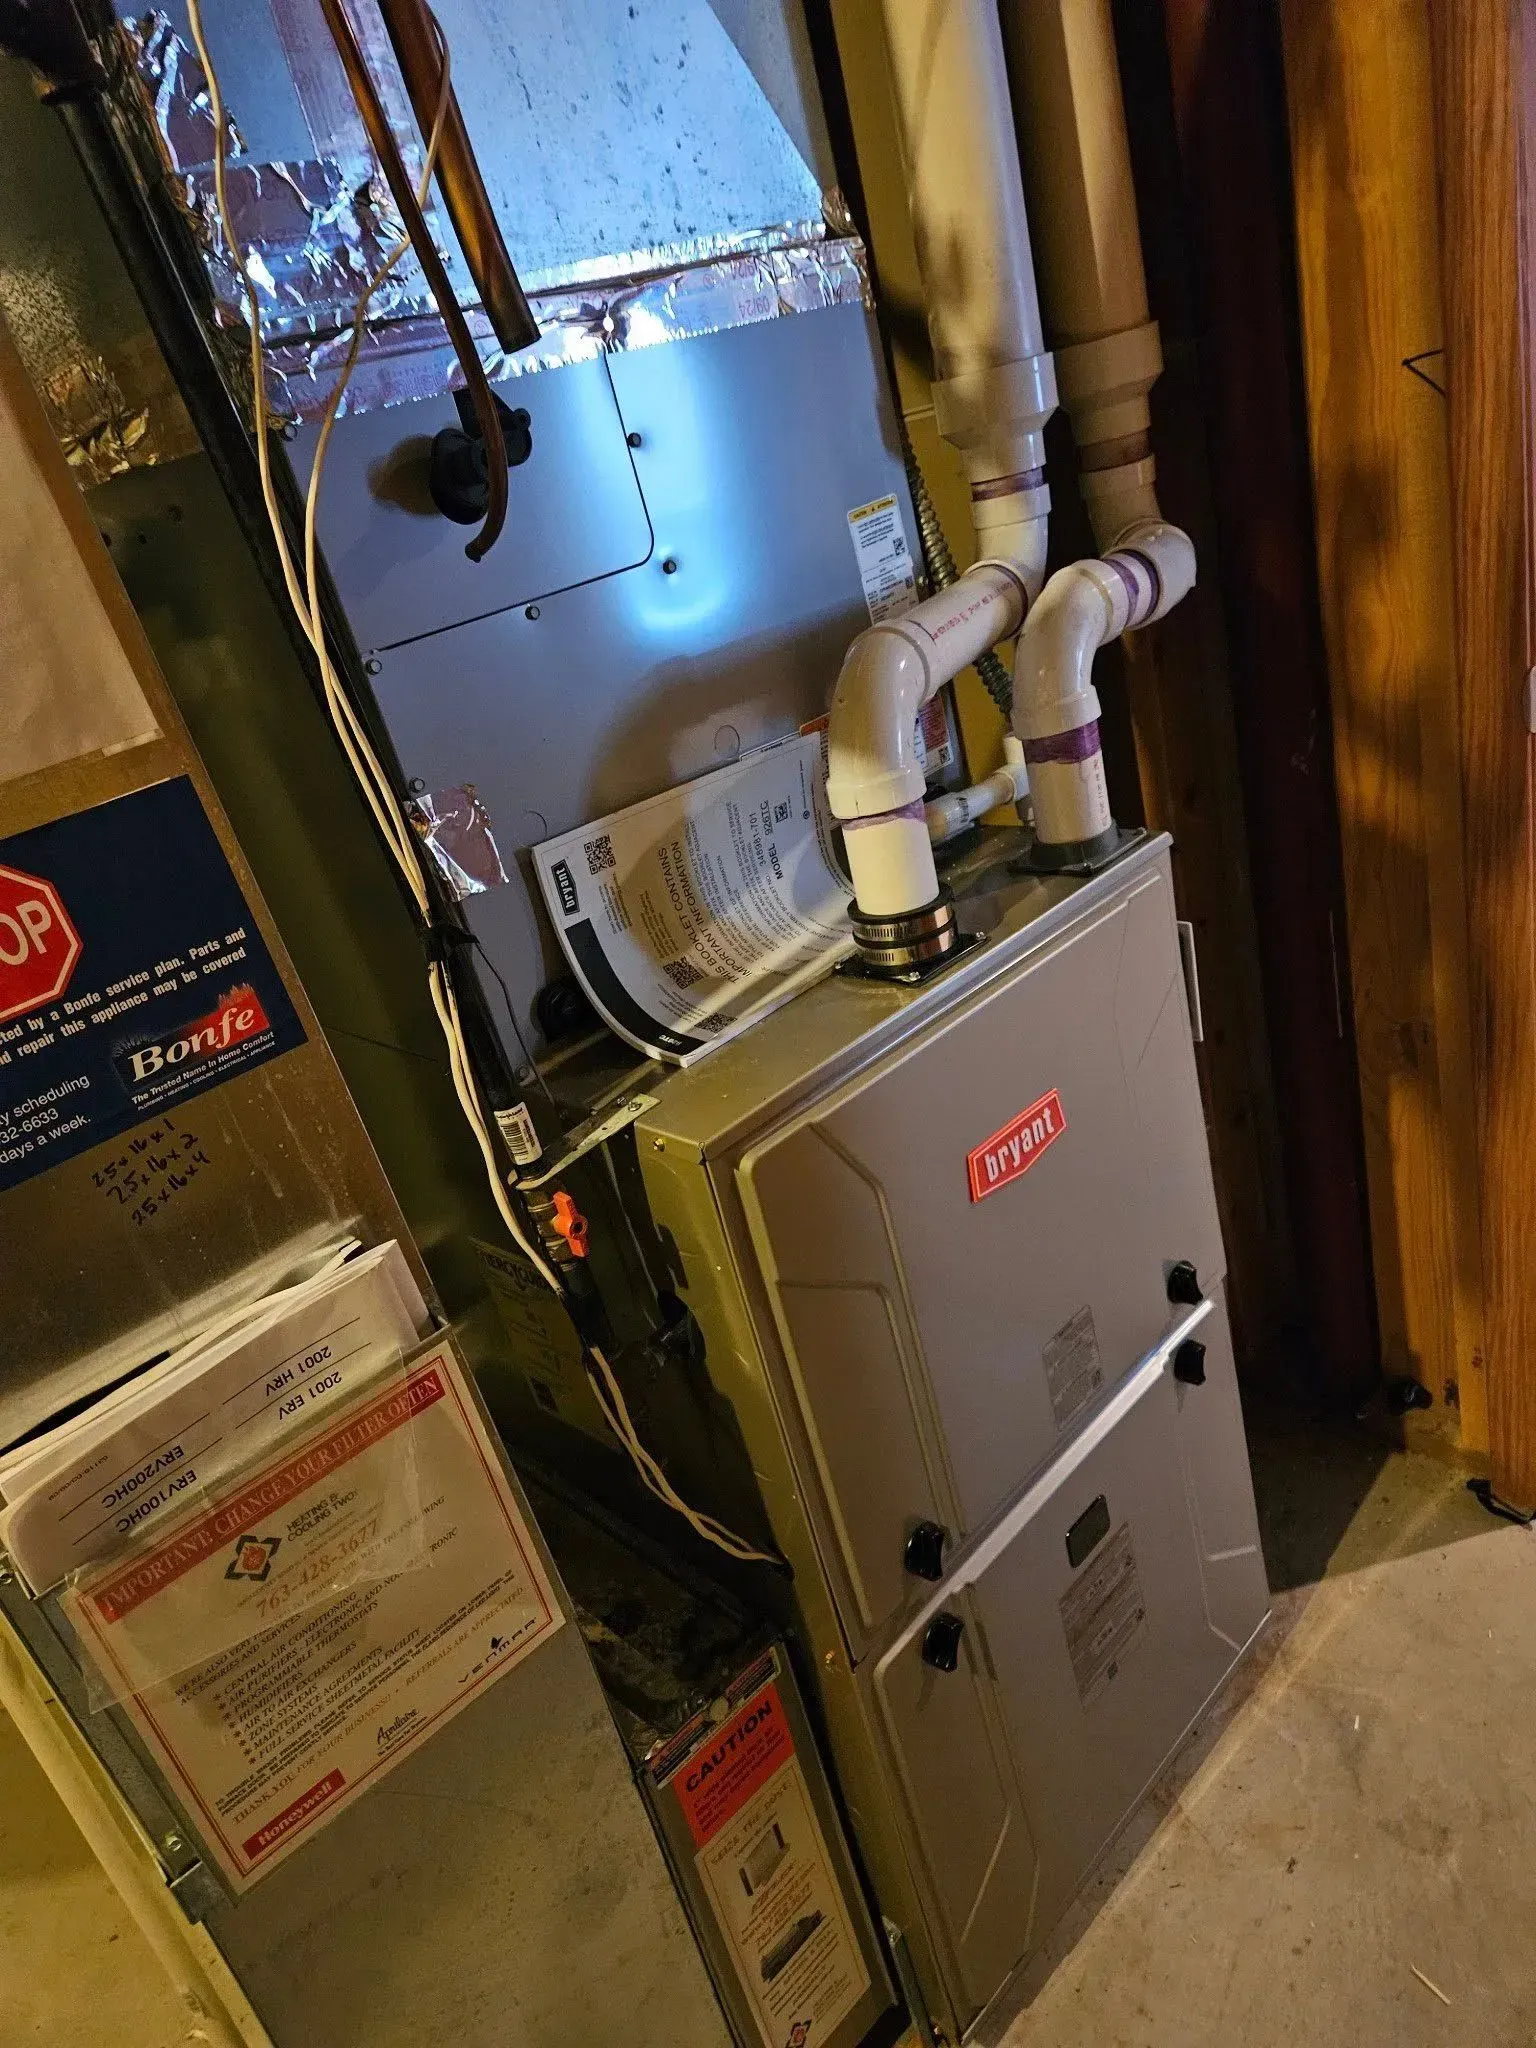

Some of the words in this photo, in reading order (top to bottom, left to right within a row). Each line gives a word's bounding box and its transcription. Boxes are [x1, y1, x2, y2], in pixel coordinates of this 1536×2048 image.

[759, 799, 772, 836] 926TC
[555, 866, 575, 908] bryant
[657, 846, 684, 911] CONTAINS
[670, 840, 704, 925] INFORMATION
[766, 842, 783, 879] MODEL
[678, 912, 717, 966] BOOKLET
[726, 915, 748, 943] APPLIANCE
[734, 906, 752, 931] BOOKLET
[700, 925, 752, 977] IMPORTANT
[714, 964, 739, 983] THIS
[0, 1024, 23, 1046] ted
[26, 1014, 46, 1033] by
[49, 1009, 60, 1021] a
[63, 989, 102, 1015] Bonfe
[104, 968, 151, 998] service
[152, 952, 185, 977] plan.
[188, 937, 220, 960] Parts
[223, 926, 246, 945] and
[15, 1031, 57, 1059] repair
[59, 1017, 86, 1037] this
[89, 989, 150, 1027] appliance
[152, 977, 179, 998] may
[181, 967, 198, 983] be
[201, 946, 247, 975] covered
[128, 1005, 256, 1083] Bonfe
[131, 1091, 149, 1105] The
[149, 1075, 182, 1096] Trusted
[181, 1062, 207, 1080] Name
[206, 1058, 217, 1068] In
[216, 1046, 241, 1063] Home
[241, 1030, 274, 1051] Comfort
[218, 1055, 246, 1071] ELECTRICAL
[250, 1040, 275, 1055] APPLIANCE
[11, 1072, 91, 1119] scheduling
[0, 1140, 34, 1164] days
[37, 1130, 48, 1145] a
[49, 1114, 91, 1139] week.
[984, 1107, 1054, 1183] bryant
[260, 1368, 295, 1396] HRV
[296, 1345, 333, 1373] 2001
[306, 1370, 343, 1398] 2001
[273, 1393, 306, 1420] ERV
[99, 1444, 184, 1509] ERV200HC
[212, 1479, 284, 1537] CHANGE
[283, 1446, 332, 1489] YOUR
[330, 1409, 387, 1457] FILTER
[386, 1376, 437, 1419] OFTEN
[113, 1468, 197, 1533] ERV100HC
[286, 1499, 328, 1531] HEATING
[328, 1491, 339, 1503] &
[286, 1507, 331, 1542] COOLING
[254, 1517, 382, 1618] 763-428-3677
[178, 1657, 240, 1706] ACCESSORIES
[240, 1642, 260, 1660] AND
[205, 1654, 228, 1674] ALSO
[228, 1638, 250, 1657] VERY
[222, 1656, 269, 1695] CENTRAL
[269, 1643, 287, 1660] AIR
[287, 1590, 357, 1646] CONDITIONING
[226, 1686, 245, 1705] AIR
[245, 1647, 298, 1690] PURIFIERS
[303, 1598, 363, 1646] ELECTRONIC
[362, 1583, 383, 1603] AND
[232, 1648, 314, 1713] PROGRAMMABLE
[315, 1599, 379, 1651] THERMOSTATS
[225, 1774, 254, 1798] TROUBLE
[279, 1728, 312, 1756] PROBLEMS
[313, 1709, 335, 1729] PLEASE
[368, 1665, 391, 1685] SERVICE
[392, 1647, 413, 1666] STATUS
[414, 1633, 431, 1648] SHEET
[432, 1612, 457, 1634] LOCATED
[467, 1590, 485, 1606] LOWER
[232, 1790, 270, 1825] THANK
[270, 1771, 294, 1794] YOU
[317, 1731, 343, 1756] YOUR
[405, 1643, 452, 1685] REFERRALS
[453, 1630, 469, 1646] ARE
[471, 1586, 523, 1632] APPRECIATED
[237, 1670, 303, 1723] HUMIDIFIERS
[241, 1714, 261, 1732] AIR
[261, 1705, 273, 1716] TO
[276, 1688, 294, 1706] AIR
[294, 1640, 357, 1691] EXCHANGERS
[247, 1716, 275, 1740] ZONE
[276, 1683, 318, 1719] SYSTEMS
[252, 1692, 322, 1750] MAINTENANCE
[322, 1645, 383, 1696] AGREEMENTS
[257, 1734, 285, 1759] FULL
[285, 1703, 324, 1737] SERVICE
[324, 1656, 384, 1706] SHEETMETAL
[383, 1626, 421, 1660] FACILITY
[373, 1700, 420, 1748] Aprilaire
[685, 1699, 772, 1794] CAUTION
[220, 1785, 258, 1817] PROCEDURE
[257, 1775, 271, 1787] MAY
[272, 1754, 298, 1776] PREVENT
[257, 1780, 333, 1848] Honeywell
